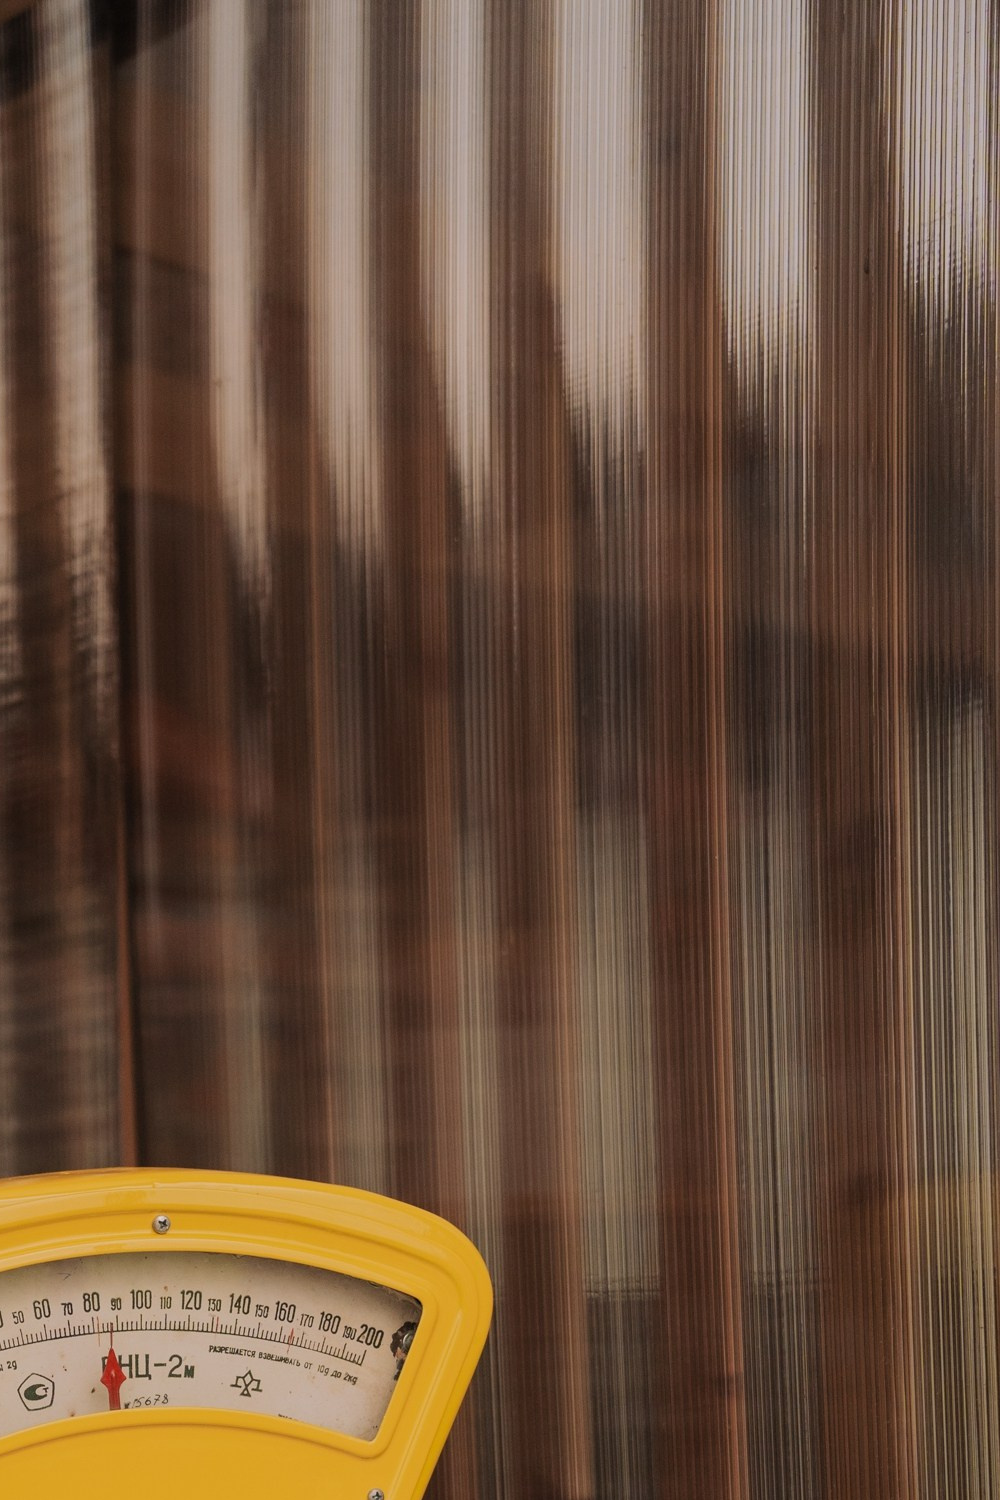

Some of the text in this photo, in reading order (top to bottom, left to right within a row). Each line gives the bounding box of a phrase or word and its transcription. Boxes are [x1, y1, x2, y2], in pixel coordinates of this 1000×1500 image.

[12, 1310, 25, 1325] 50
[32, 1298, 51, 1320] 60
[61, 1302, 73, 1316] 70
[82, 1291, 101, 1313] 80
[110, 1297, 122, 1311] 90
[130, 1289, 152, 1310] 100
[160, 1296, 172, 1310] 110
[180, 1289, 202, 1311] 120
[207, 1298, 221, 1312] 130
[229, 1292, 251, 1315] 140
[255, 1304, 269, 1319] 150
[274, 1300, 297, 1323] 160
[300, 1313, 315, 1328] 170
[318, 1310, 341, 1335] 180
[342, 1325, 357, 1341] 190
[357, 1323, 384, 1349] 200
[208, 1344, 256, 1359] РАЗРЕШАЕТСЯ
[258, 1351, 301, 1367] ВЗВЕШИВАТЬ
